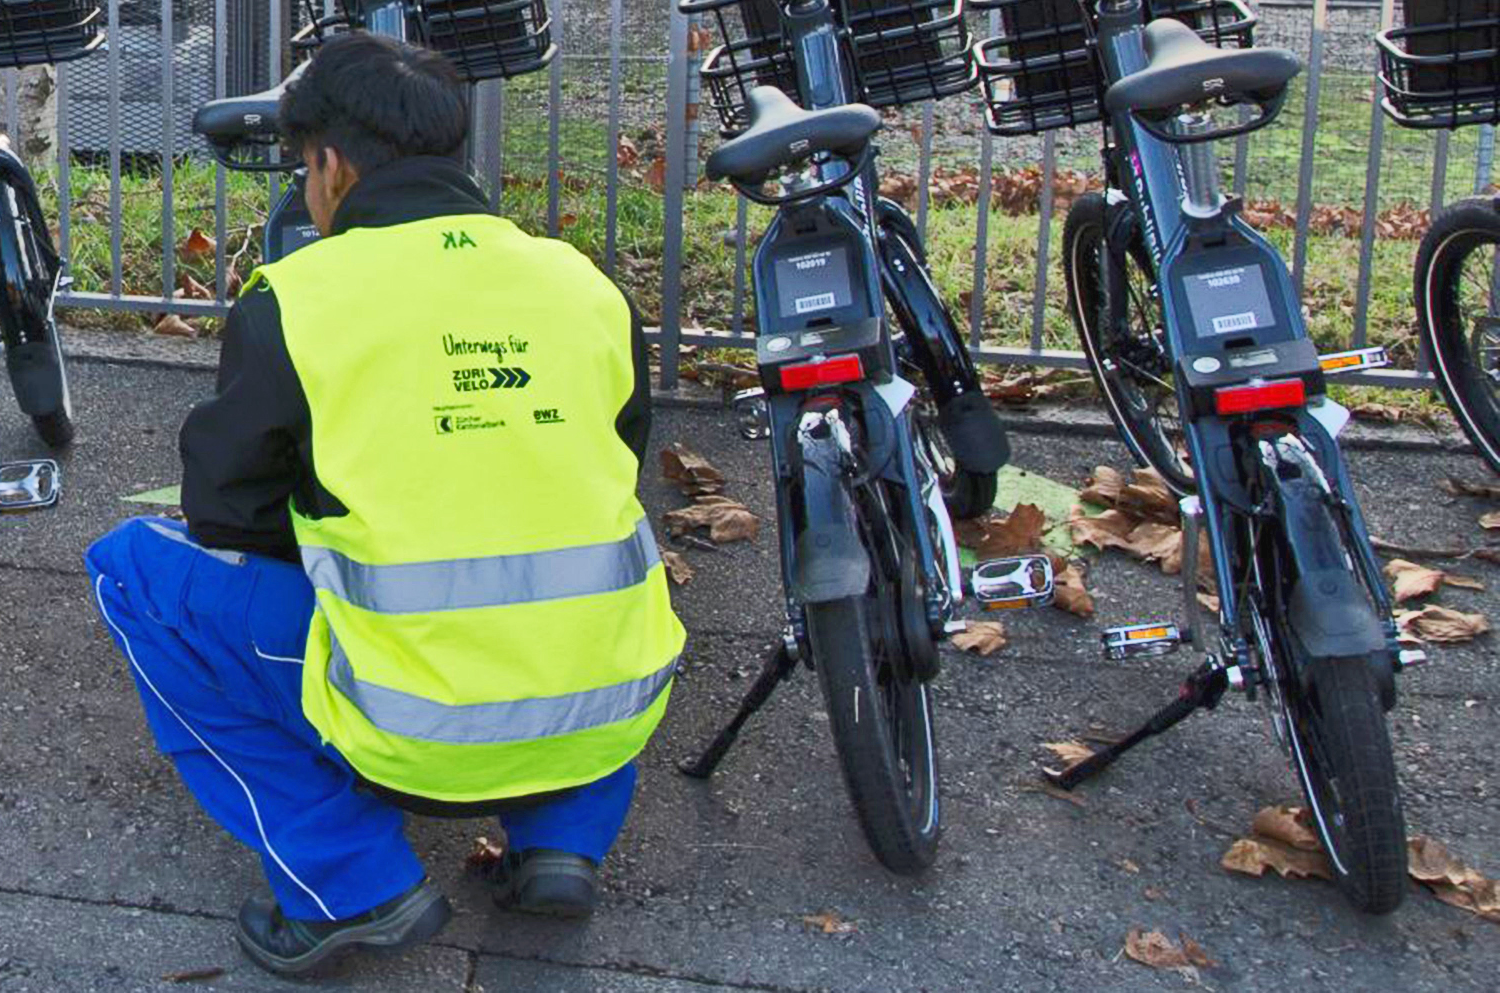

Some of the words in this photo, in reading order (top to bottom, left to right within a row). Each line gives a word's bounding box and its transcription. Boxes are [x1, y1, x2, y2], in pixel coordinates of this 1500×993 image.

[443, 334, 507, 363] Unterwegs
[508, 335, 529, 354] für
[453, 368, 485, 381] ZÜRI
[454, 379, 490, 392] VELO
[533, 409, 559, 420] ewz
